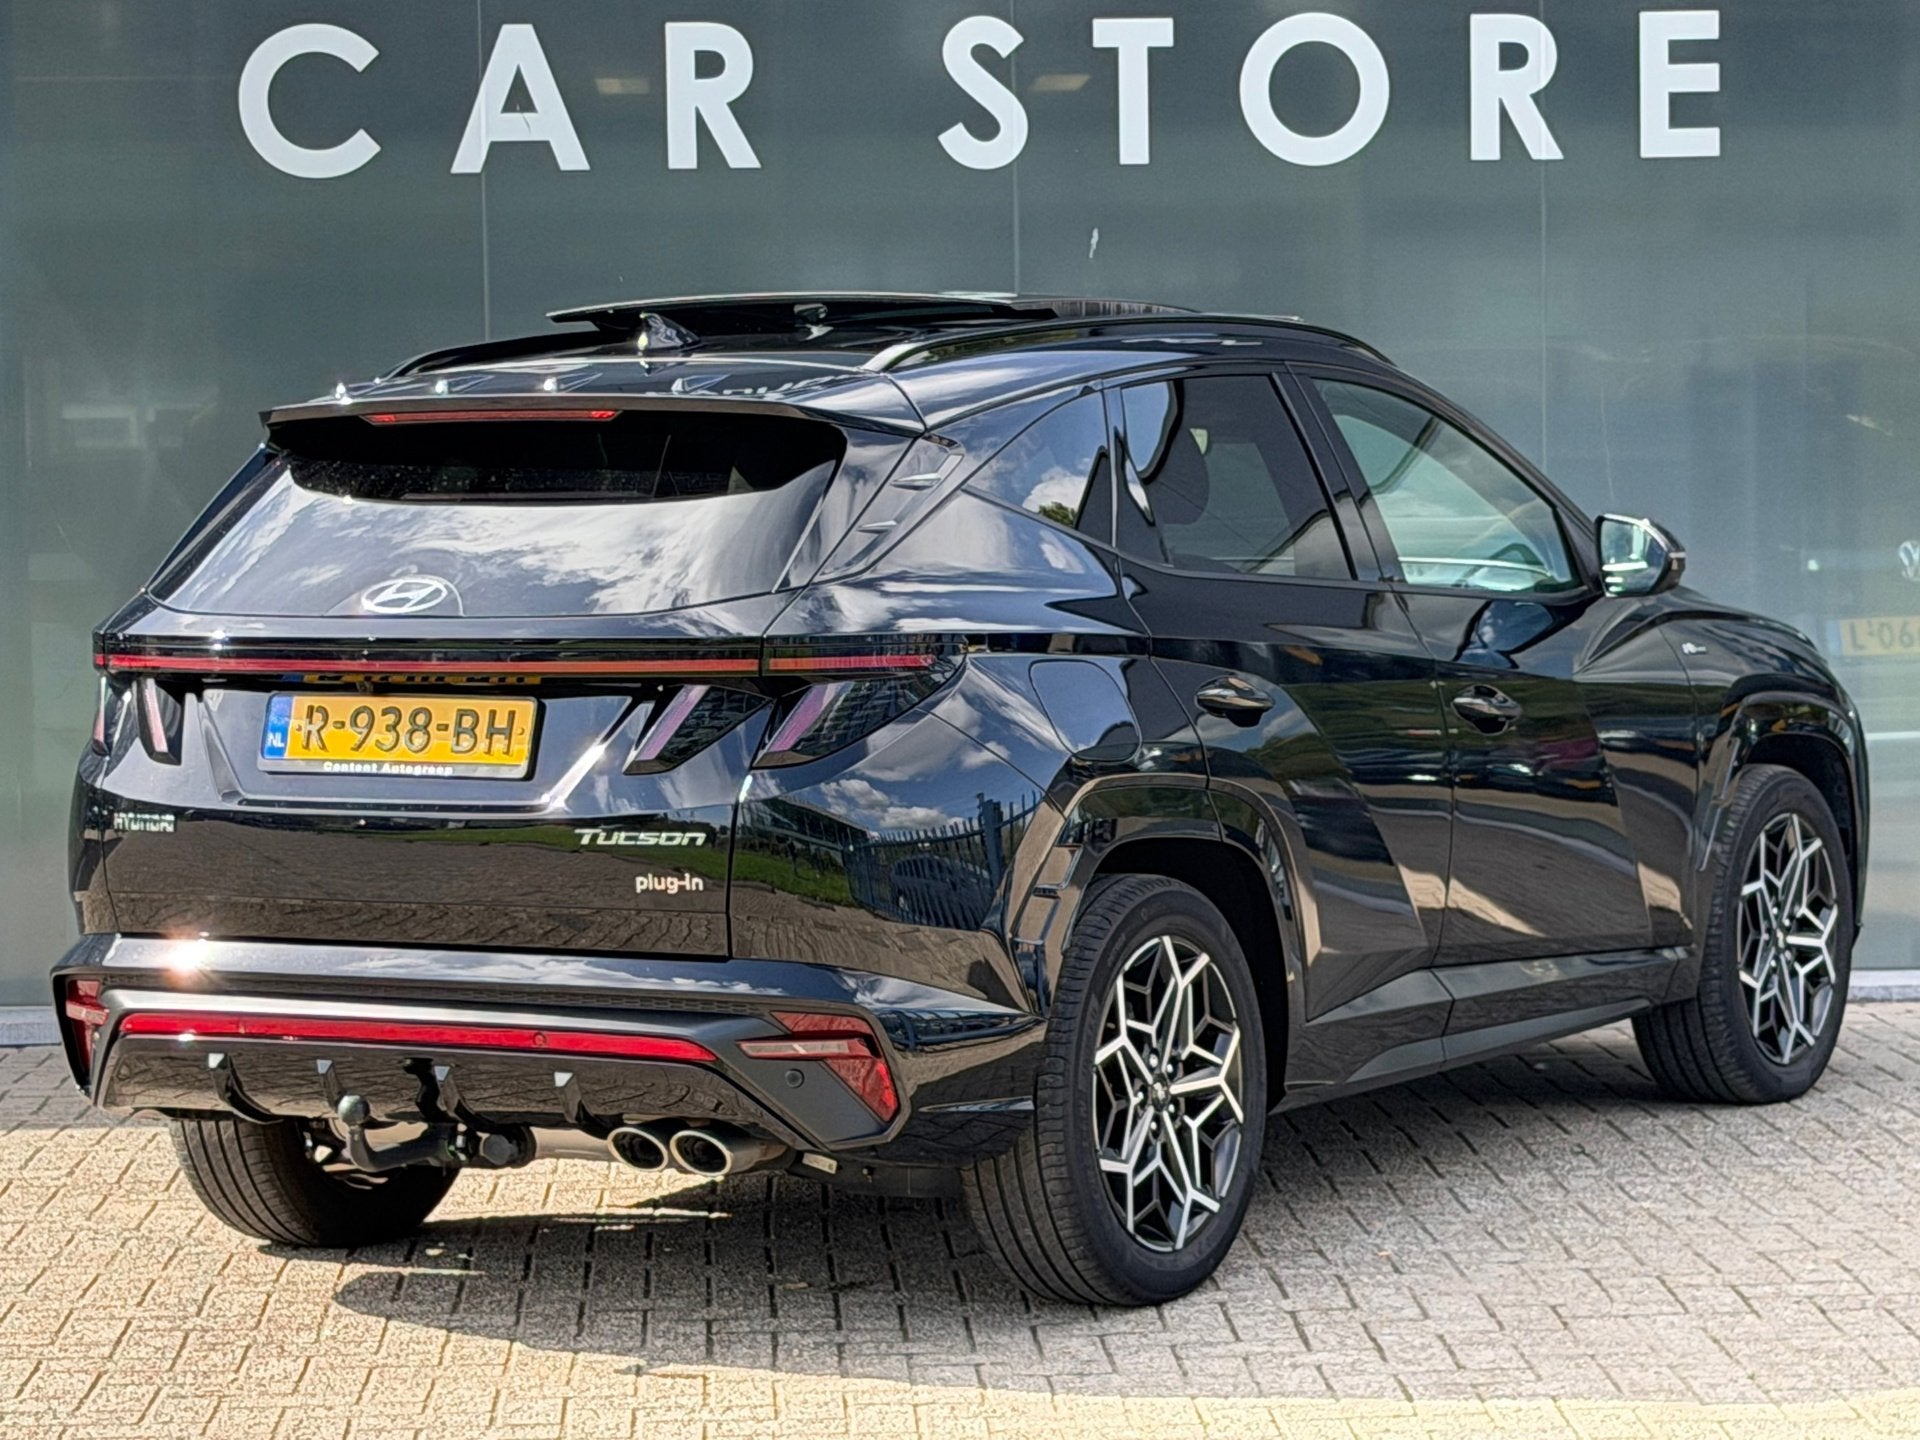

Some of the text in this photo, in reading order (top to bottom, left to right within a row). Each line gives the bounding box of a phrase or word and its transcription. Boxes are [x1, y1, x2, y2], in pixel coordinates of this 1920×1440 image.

[238, 10, 1721, 179] CAR STORE
[1849, 618, 1920, 651] L-06
[267, 732, 285, 748] NL
[302, 704, 517, 757] R-938-BH
[635, 873, 704, 894] plug-in
